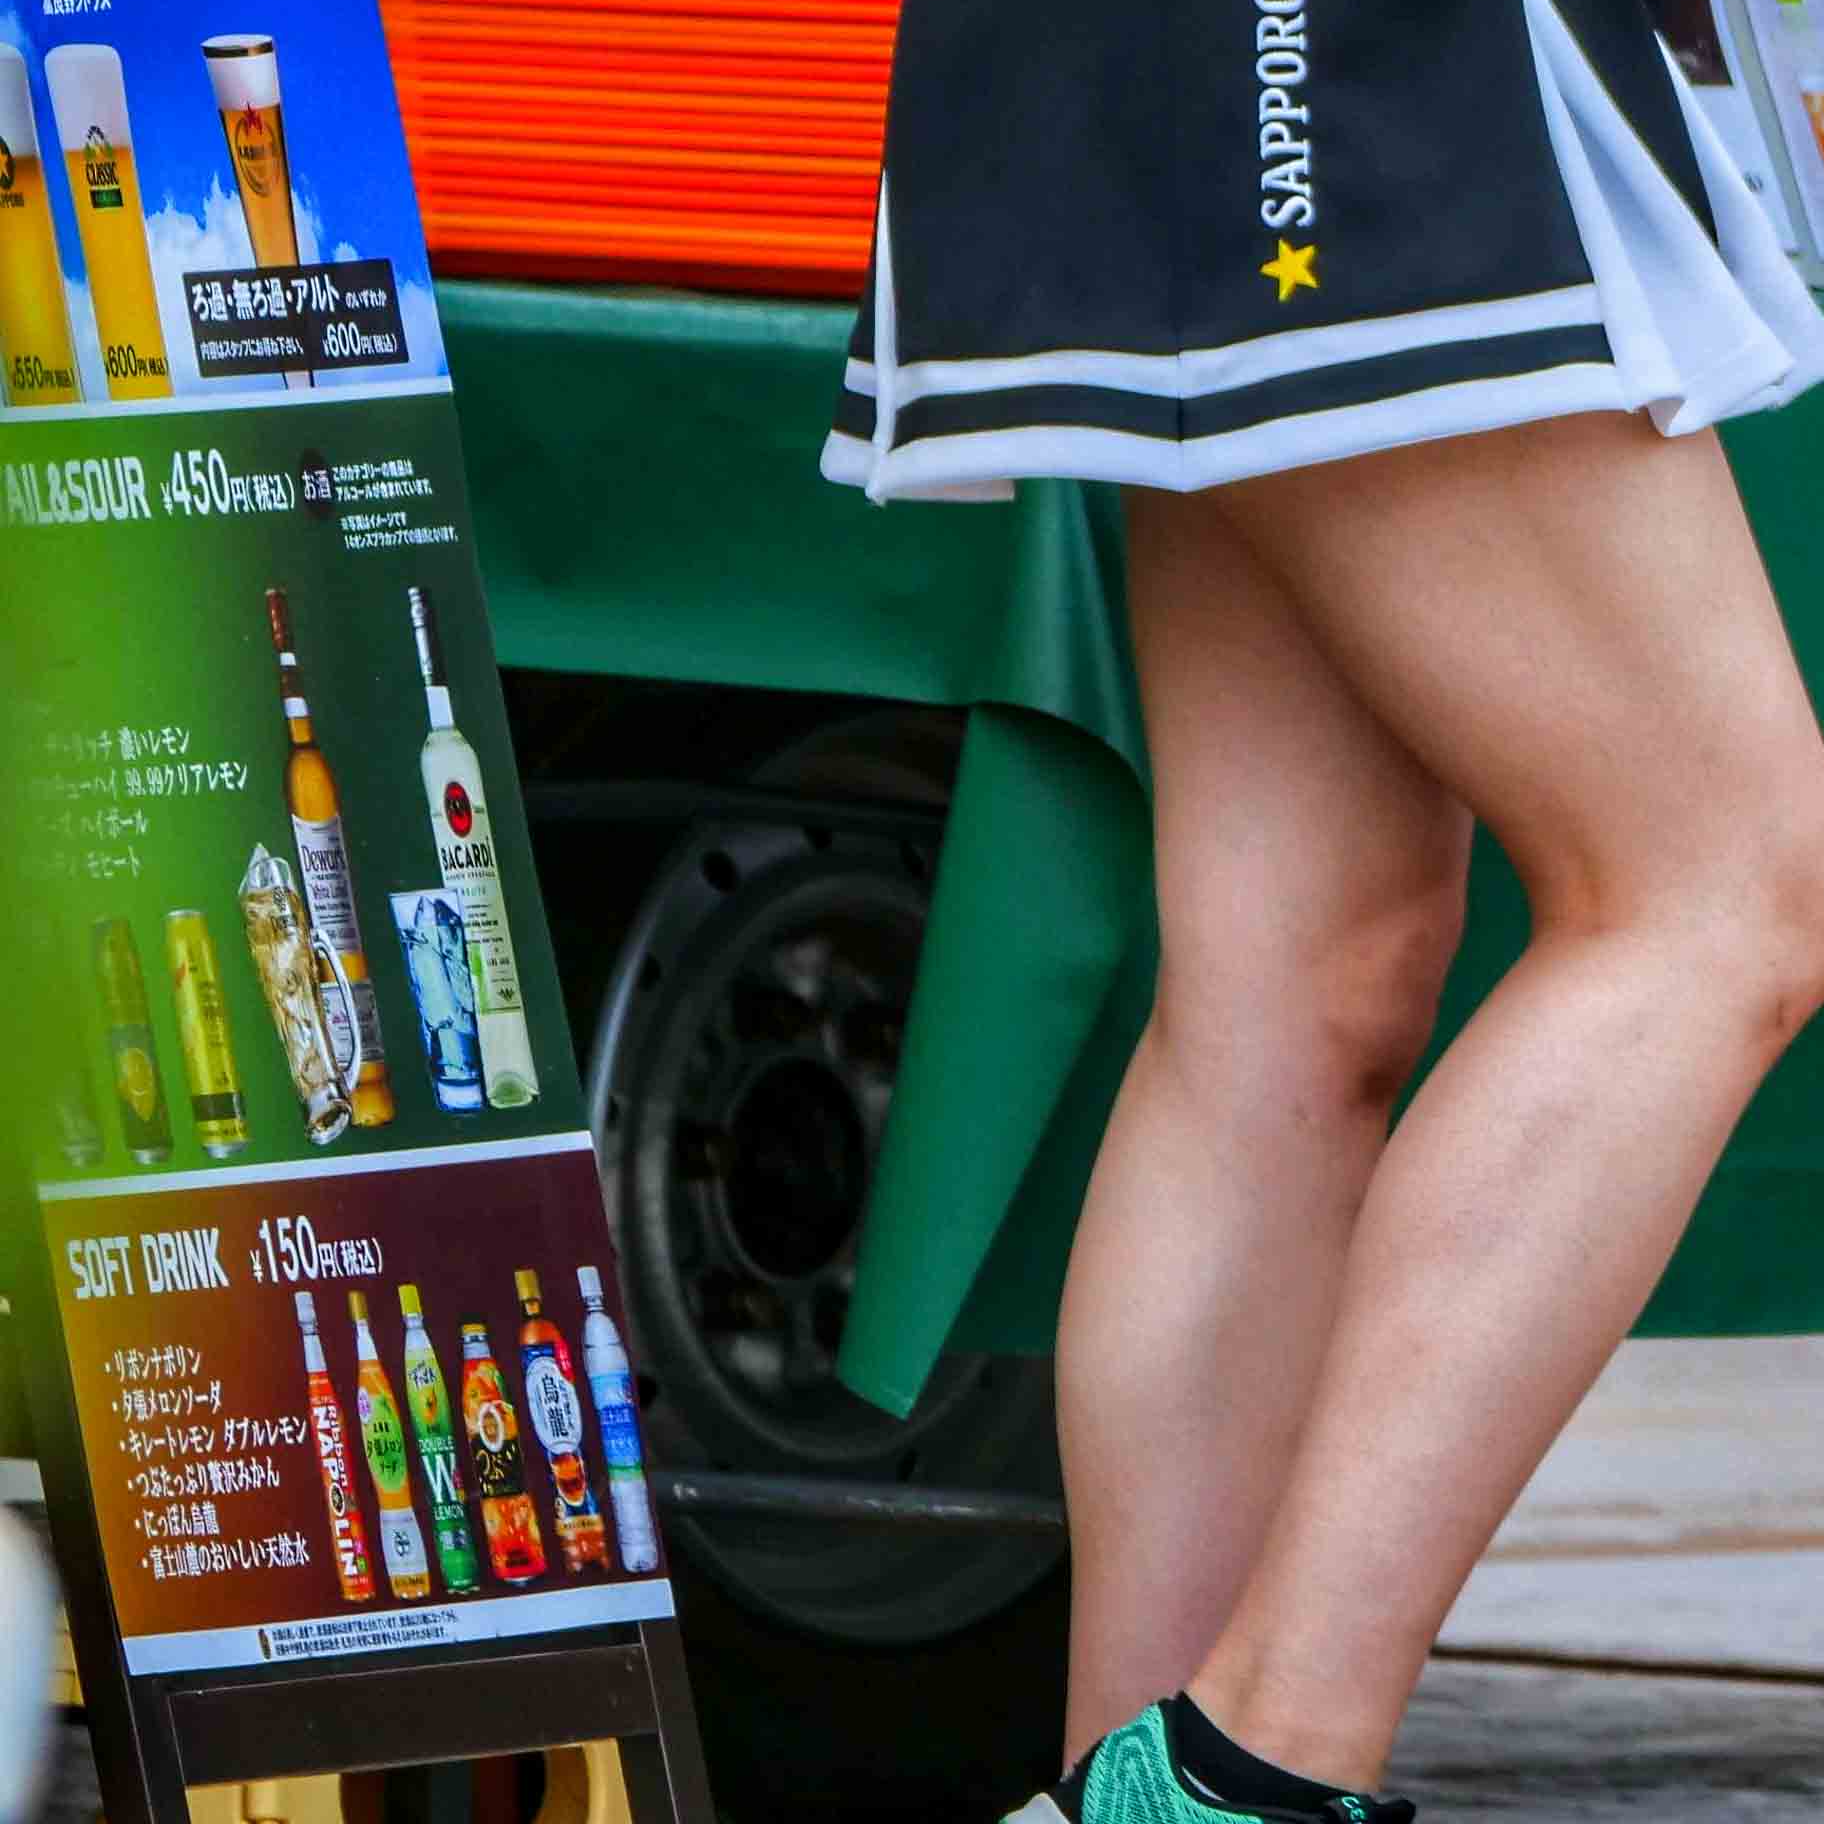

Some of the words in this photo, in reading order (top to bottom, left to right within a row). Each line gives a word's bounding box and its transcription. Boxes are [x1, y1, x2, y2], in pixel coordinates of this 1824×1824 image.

[85, 161, 119, 185] CLASSIC
[191, 273, 340, 322] ろ過・無ろ過・アルト
[322, 321, 398, 360] ¥600円(税込)
[302, 469, 332, 501] お酒
[119, 726, 192, 761] 濃いレモン
[124, 761, 248, 797] 99.99クリアレモン
[67, 1235, 132, 1299] SOFT
[142, 1226, 229, 1292] DRINK
[249, 1214, 384, 1284] ¥150円(税込)
[224, 1416, 308, 1453] ダブルレモン
